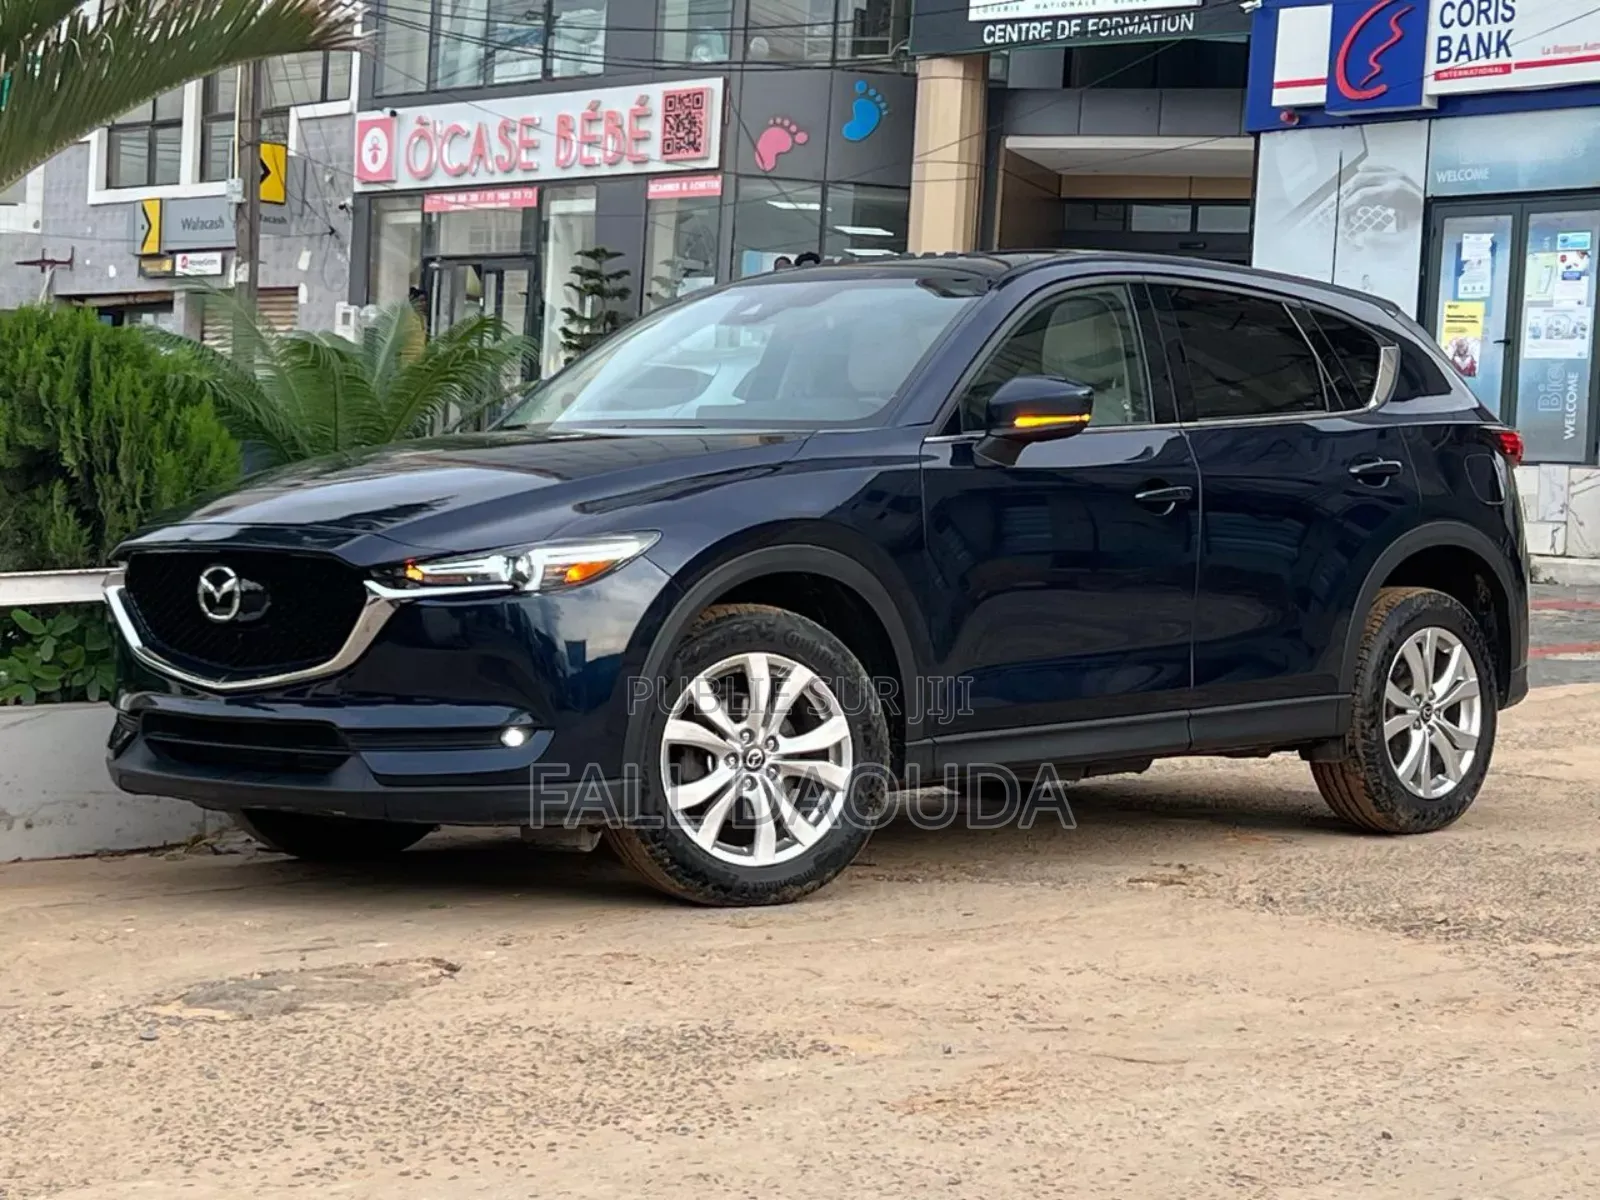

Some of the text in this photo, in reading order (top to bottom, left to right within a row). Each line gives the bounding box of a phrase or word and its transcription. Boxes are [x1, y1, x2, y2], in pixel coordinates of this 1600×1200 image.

[983, 12, 1195, 44] CENTRE DE FORMATION
[1439, 0, 1516, 30] CORIS
[1436, 28, 1514, 64] BANK
[1438, 66, 1505, 80] INTERNATIONAL
[556, 94, 651, 168] BÉBÉ
[1436, 167, 1490, 183] WELCOME
[1563, 371, 1579, 440] WELCOME
